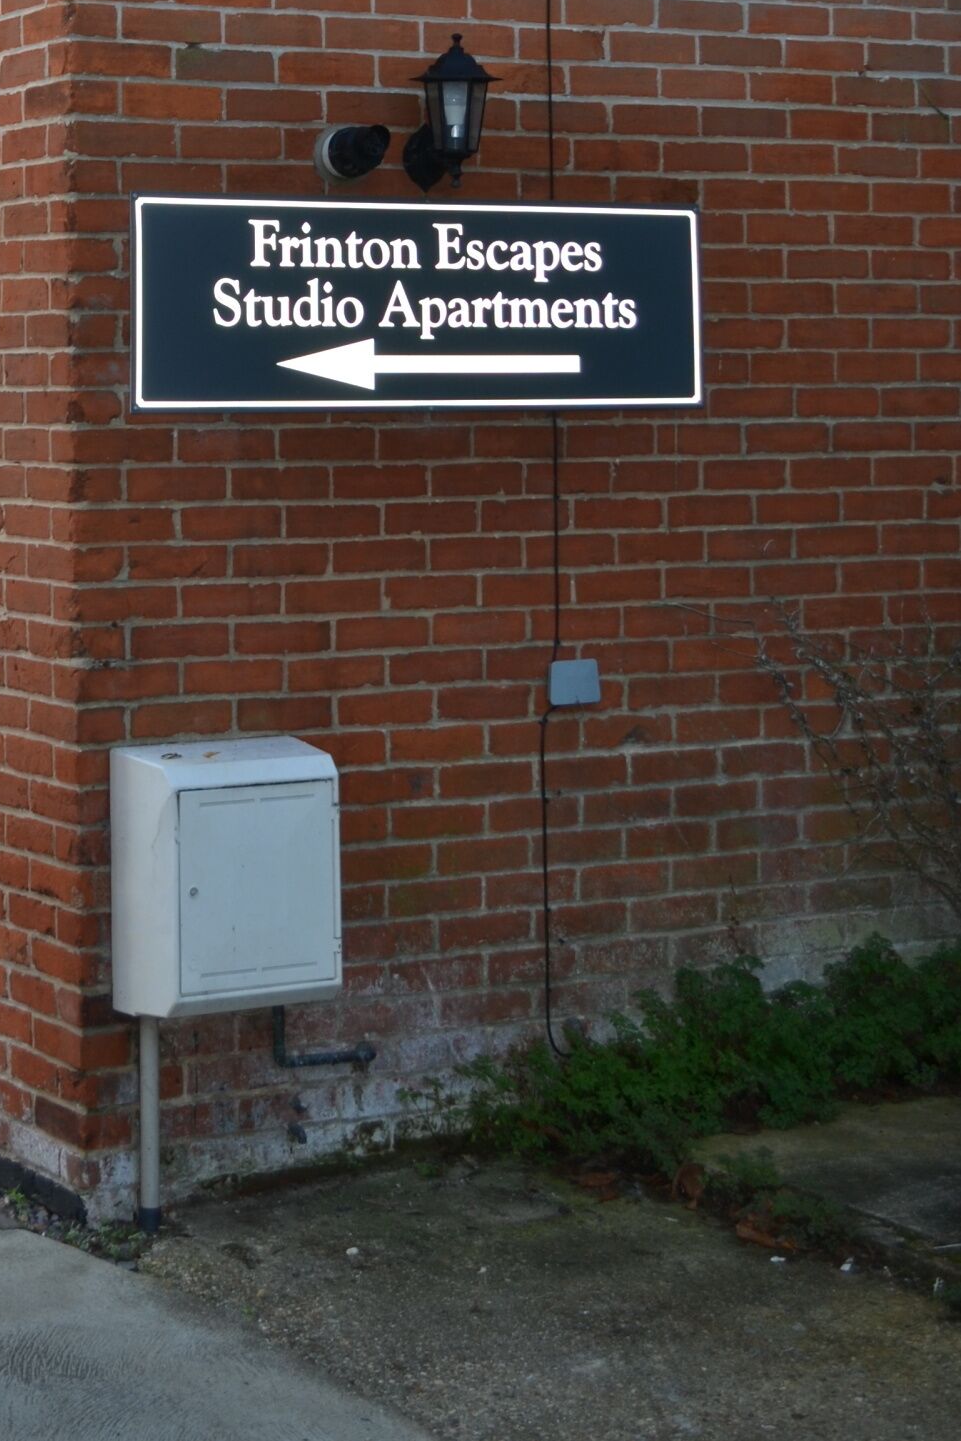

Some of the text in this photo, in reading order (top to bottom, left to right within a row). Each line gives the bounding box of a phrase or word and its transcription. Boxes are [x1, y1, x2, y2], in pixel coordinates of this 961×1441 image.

[247, 218, 603, 284] Frinton Escapes
[212, 276, 638, 341] Studio Apartments
